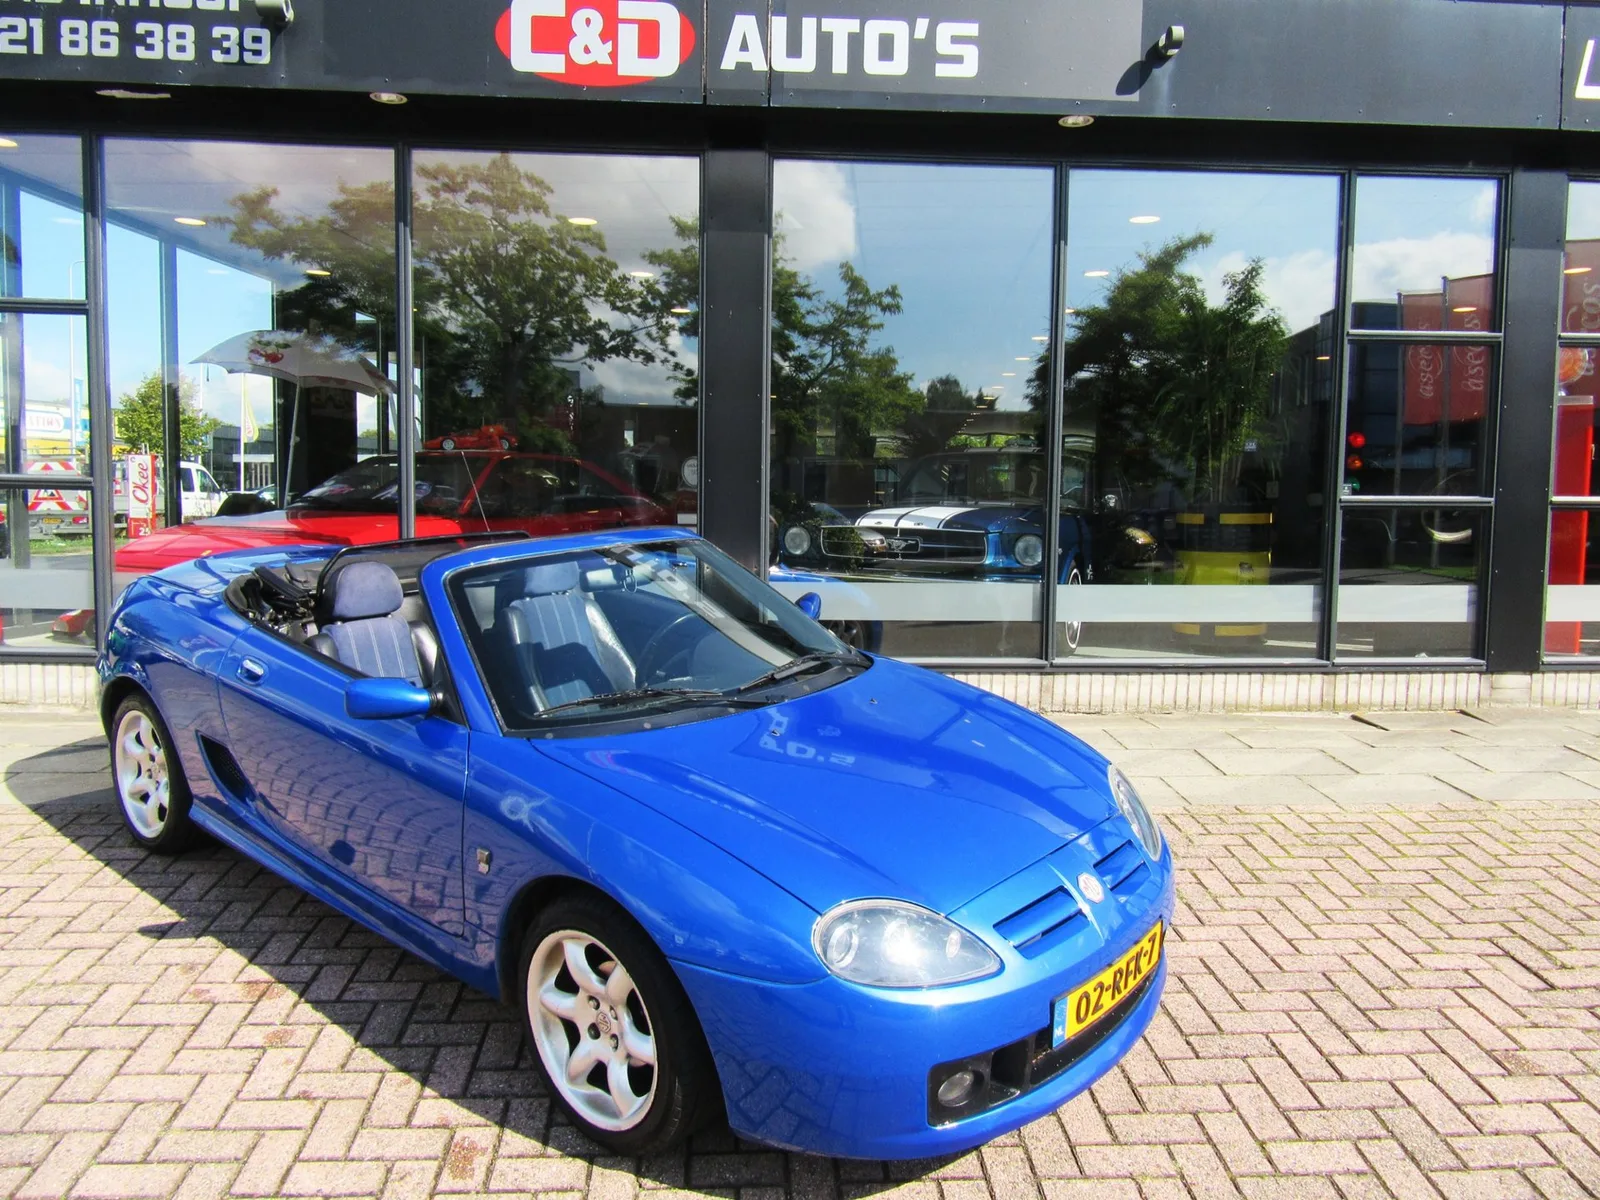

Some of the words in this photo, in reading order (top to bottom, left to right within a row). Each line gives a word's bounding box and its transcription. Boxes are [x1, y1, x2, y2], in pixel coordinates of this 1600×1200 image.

[0, 17, 43, 54] 21
[60, 19, 119, 57] 86
[135, 22, 195, 61] 38
[211, 26, 271, 64] 39
[510, 0, 681, 78] C&D
[720, 15, 979, 78] AUTO'S
[1075, 931, 1158, 1025] 02-RFK-7
